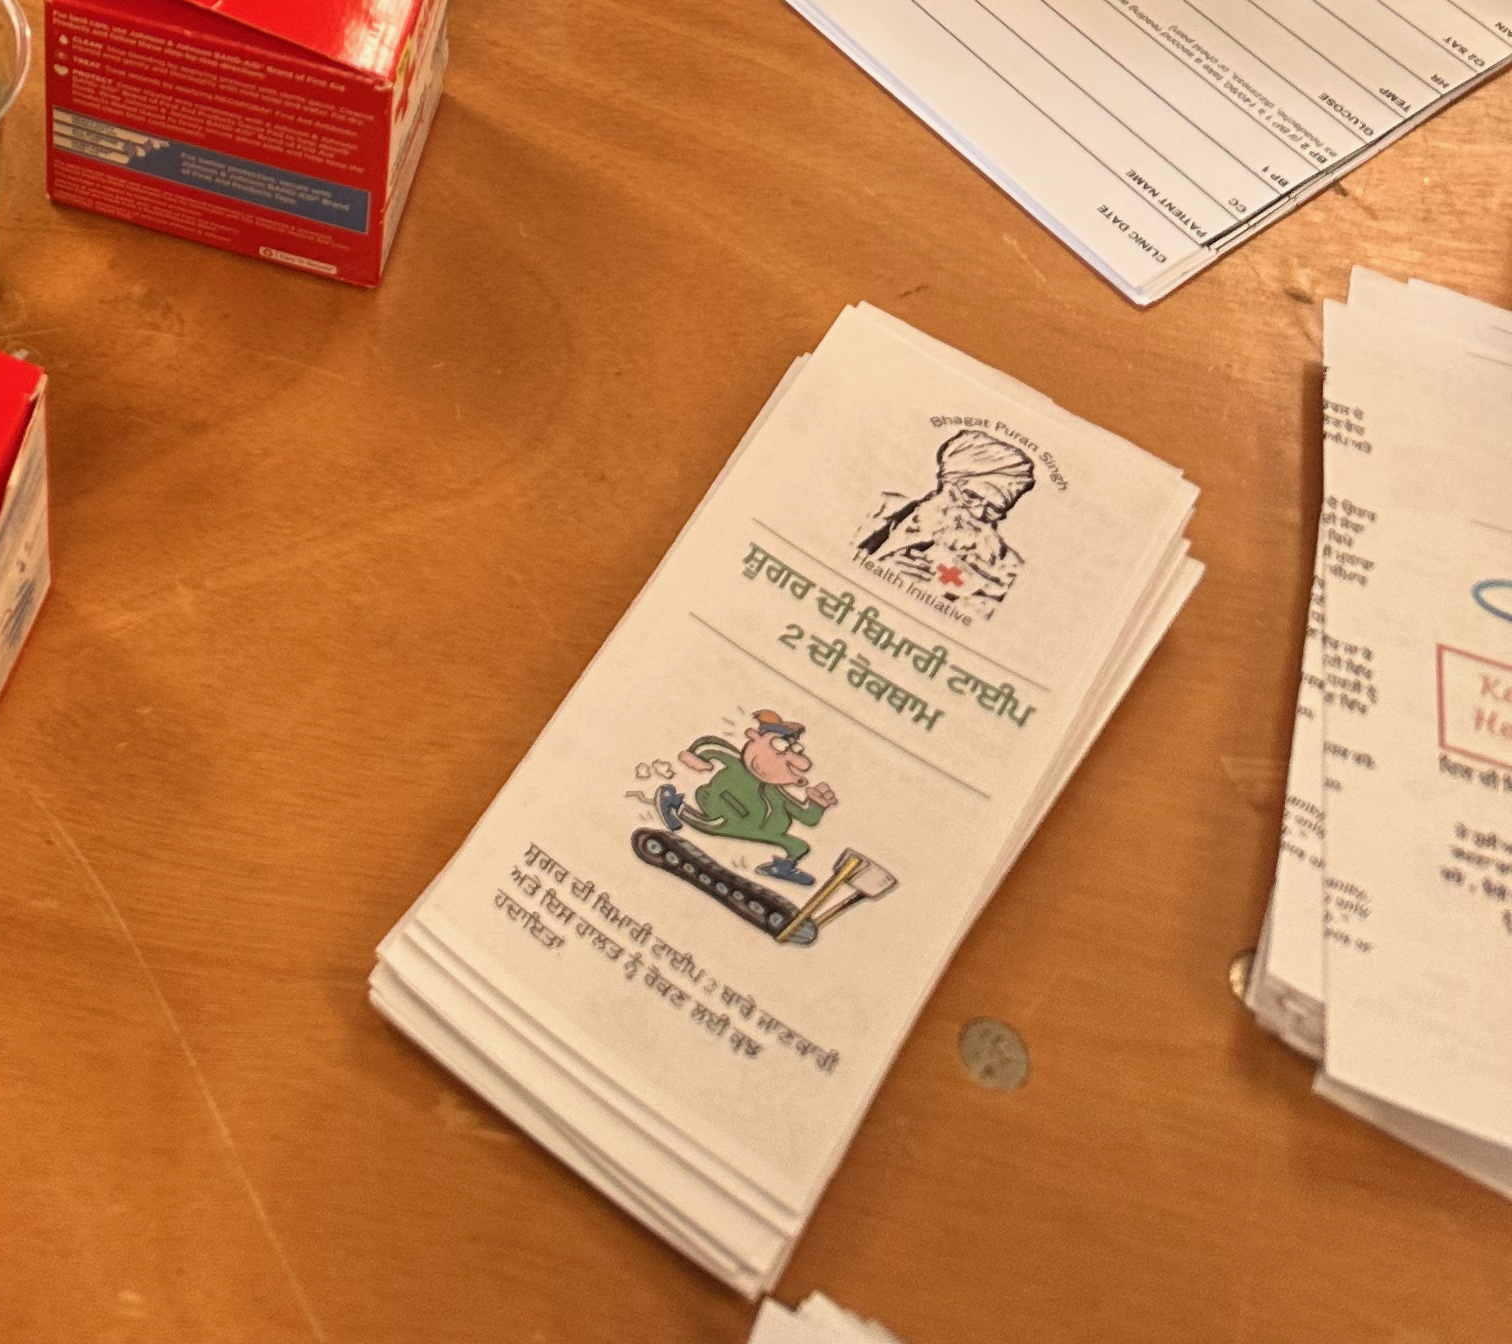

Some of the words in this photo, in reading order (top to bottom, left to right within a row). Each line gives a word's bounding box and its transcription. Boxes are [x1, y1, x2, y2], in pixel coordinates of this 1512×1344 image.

[1444, 36, 1468, 54] SAT
[1318, 92, 1374, 136] GLUCOSE
[1378, 87, 1410, 112] TEMP
[1126, 169, 1159, 198] NAME
[1096, 204, 1130, 232] DATE
[1157, 197, 1207, 238] PATIENT
[1227, 197, 1247, 213] CC
[1127, 230, 1167, 263] CLINIC
[929, 415, 989, 440] Bhagat
[994, 420, 1039, 453] Puran
[1027, 451, 1068, 491] Singh
[851, 549, 904, 588] Health
[905, 581, 972, 626] Initiative
[777, 622, 805, 650] 2
[807, 634, 847, 673] ਦੀ
[816, 587, 855, 625] ਦੀ
[851, 606, 948, 678] ਬਿਮਾਰੀ
[946, 664, 1035, 727] ਟਾਈਪ
